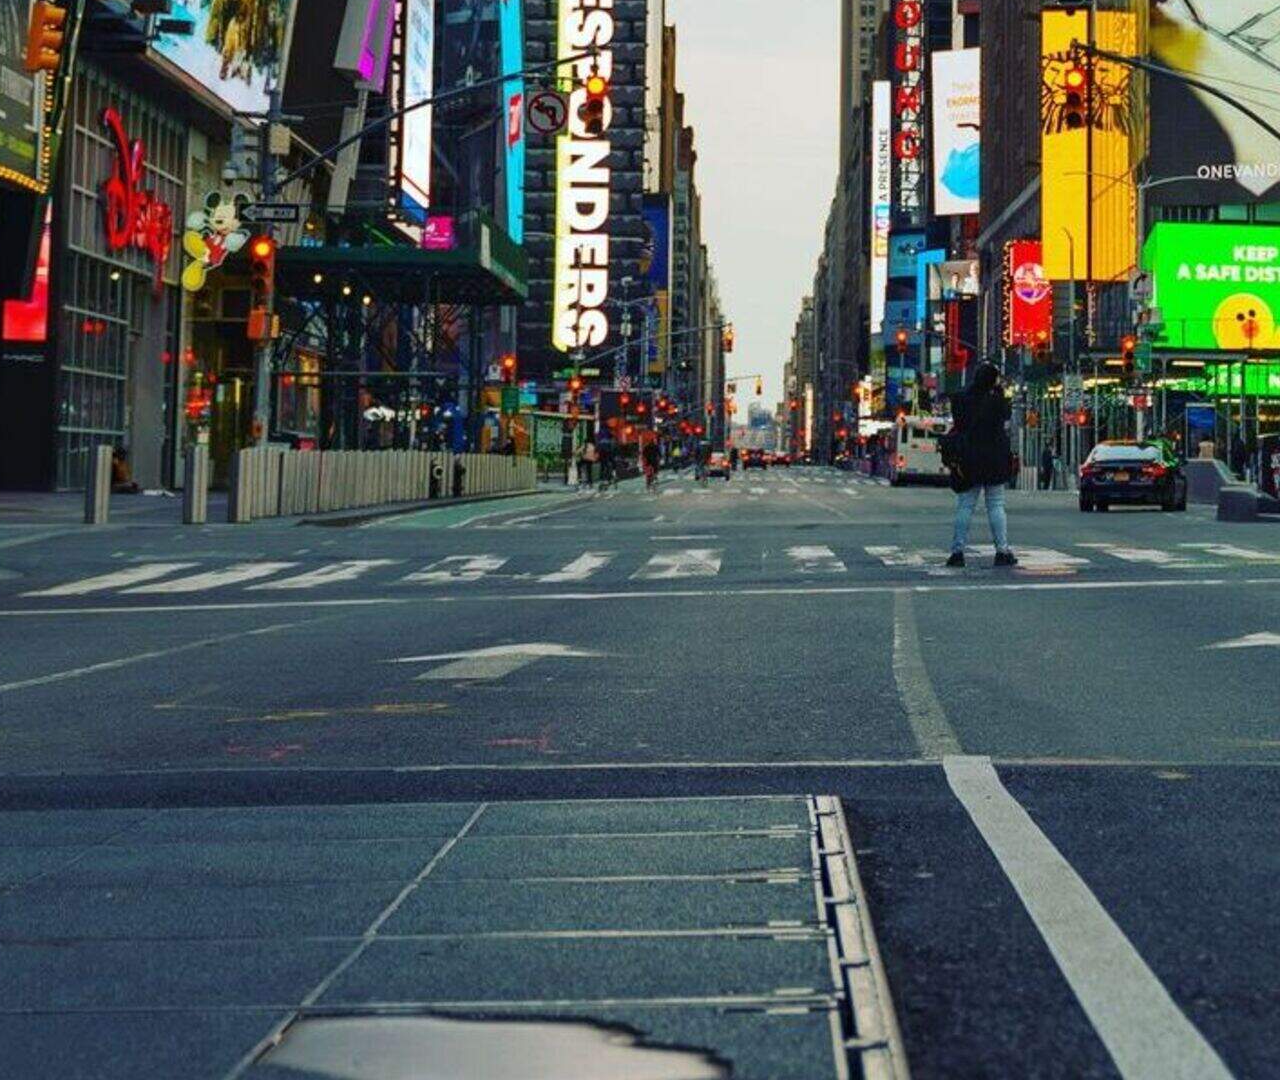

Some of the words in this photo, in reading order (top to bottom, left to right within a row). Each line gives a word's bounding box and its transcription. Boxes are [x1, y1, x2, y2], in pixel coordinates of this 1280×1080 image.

[1233, 246, 1278, 262] KEEP
[1177, 264, 1192, 280] A
[1195, 264, 1242, 282] SAFE
